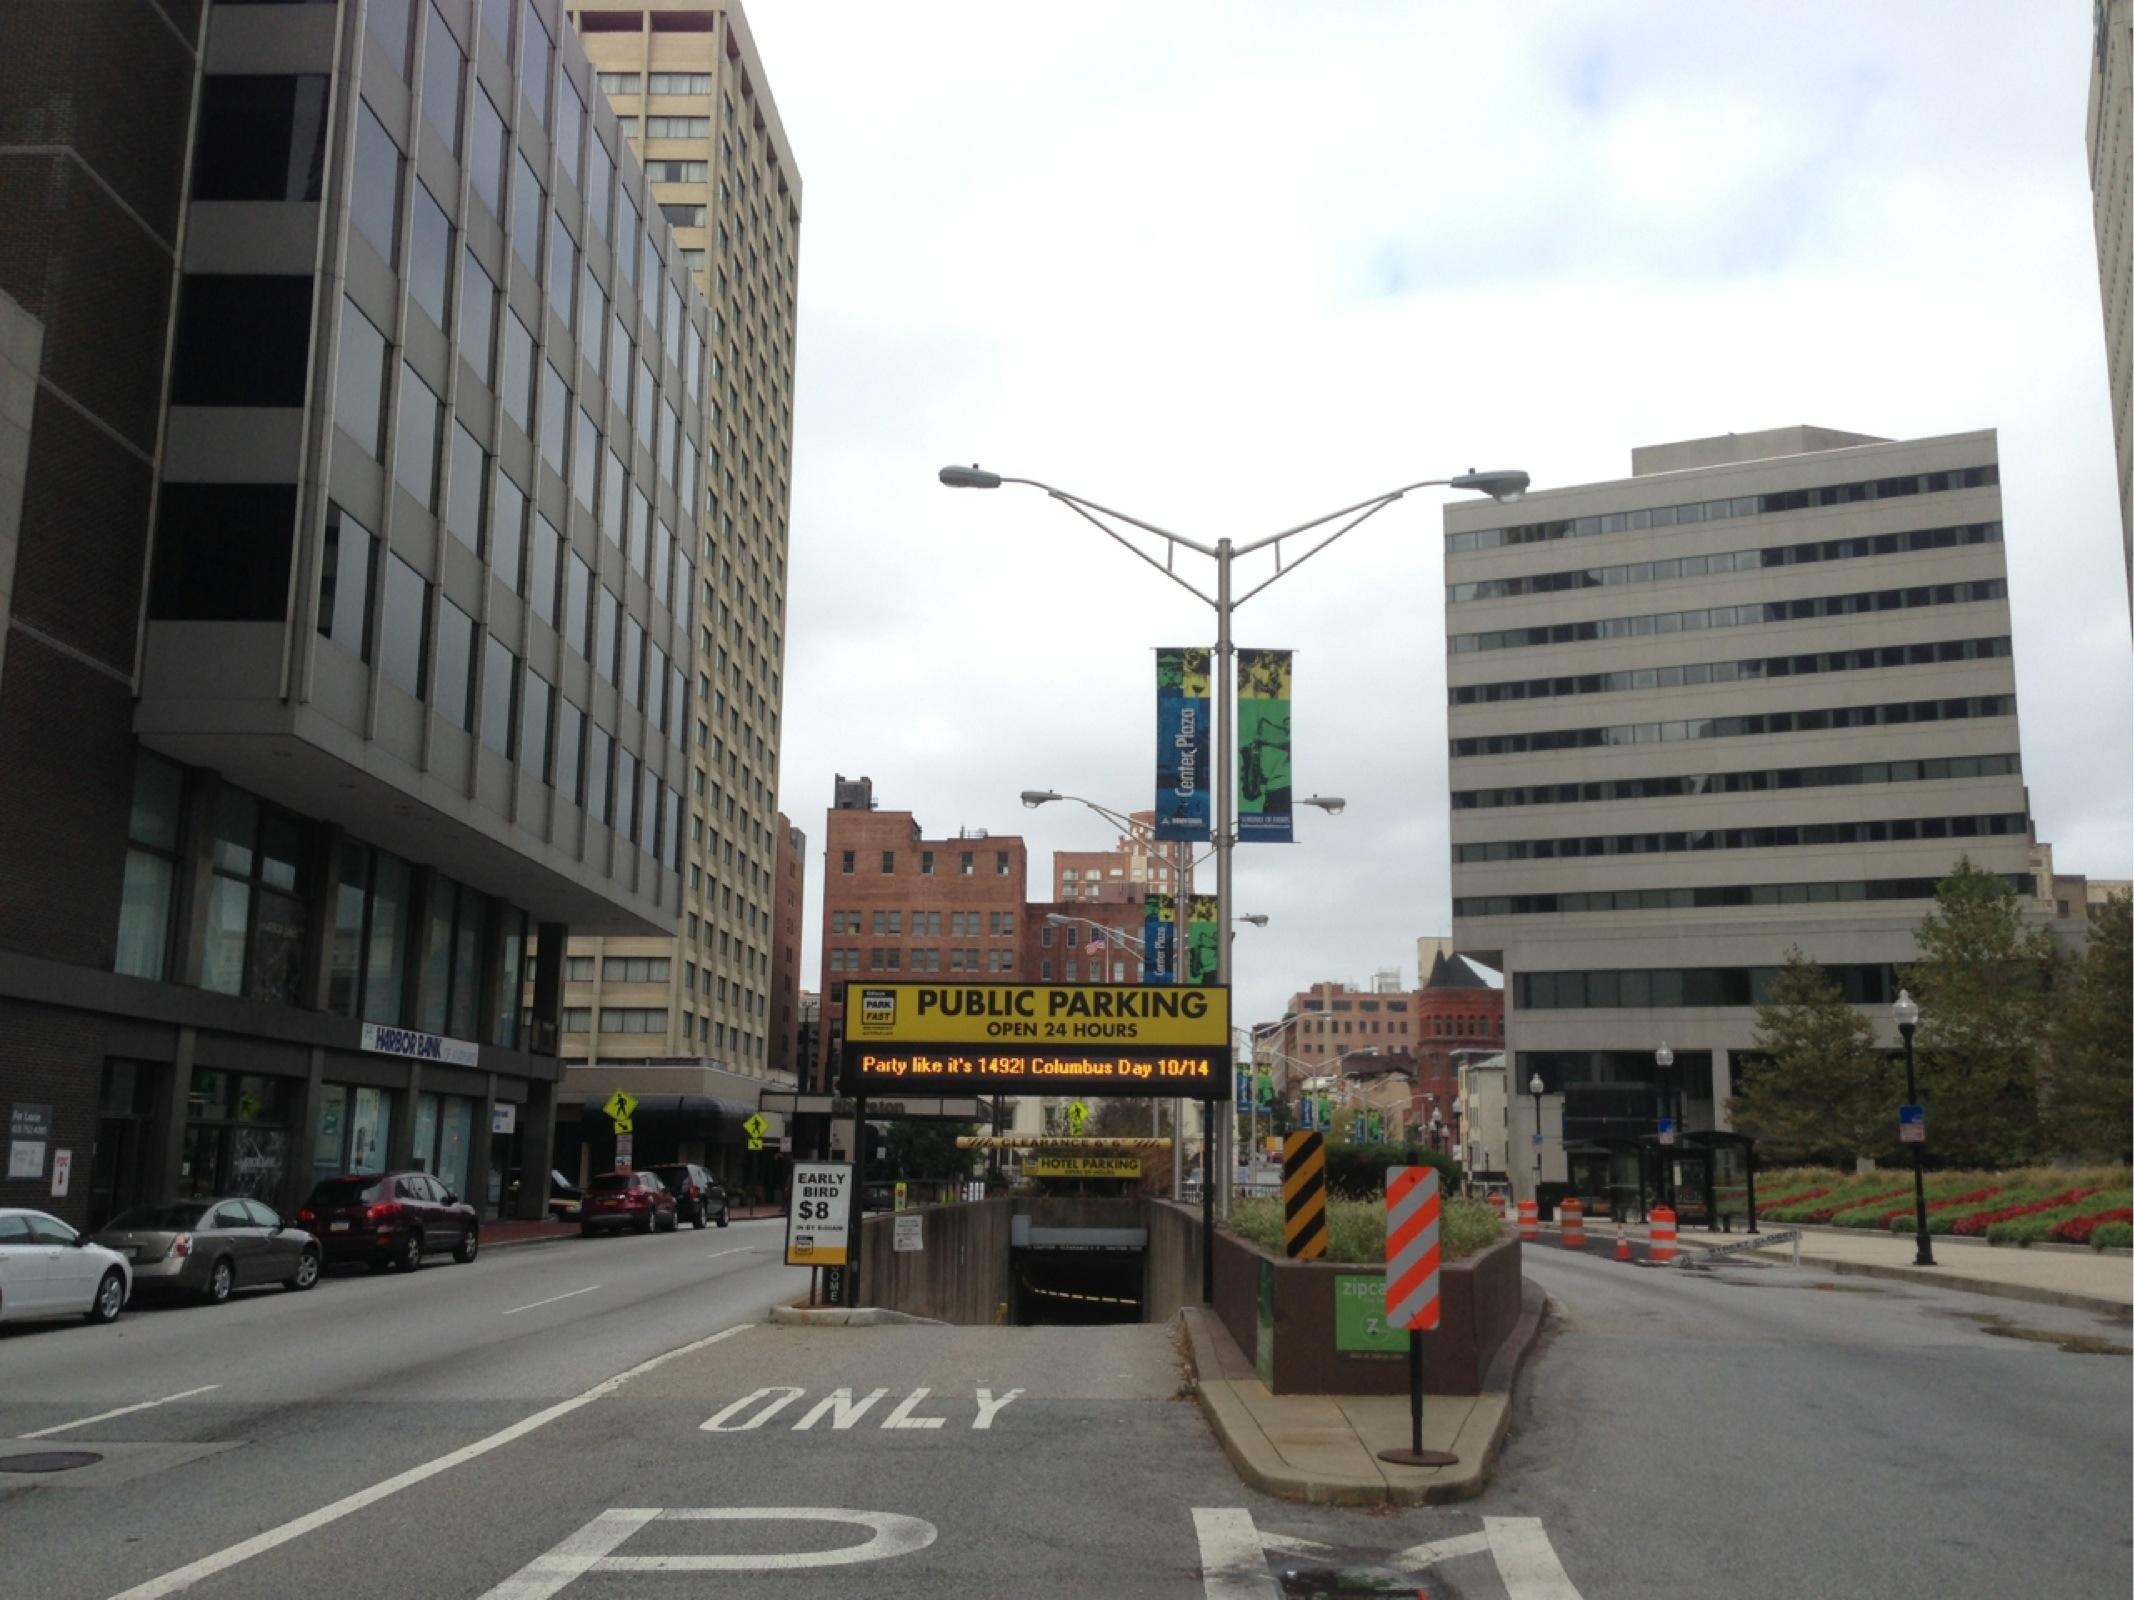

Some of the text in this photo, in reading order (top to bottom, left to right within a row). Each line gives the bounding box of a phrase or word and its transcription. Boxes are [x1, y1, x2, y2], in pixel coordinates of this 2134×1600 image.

[1175, 708, 1197, 797] Center Plaza
[866, 1001, 892, 1009] PARK
[917, 990, 1208, 1018] PUBLIC PARKING
[866, 1012, 890, 1020] FAST
[986, 1022, 1138, 1038] OPEN 24 HOURS
[376, 1027, 417, 1055] HARBOR
[418, 1034, 442, 1059] BANK
[862, 1056, 1208, 1078] Party like it's 1492! Columbus Day 10/14
[1002, 1137, 1088, 1148] CLEARANCE
[1041, 1158, 1138, 1170] HOTEL PARKING
[798, 1172, 846, 1184] EARLY
[803, 1186, 839, 1198] BIRD
[798, 1200, 829, 1220] $8
[1343, 1278, 1386, 1299] zipca
[698, 1386, 1024, 1432] ONLY
